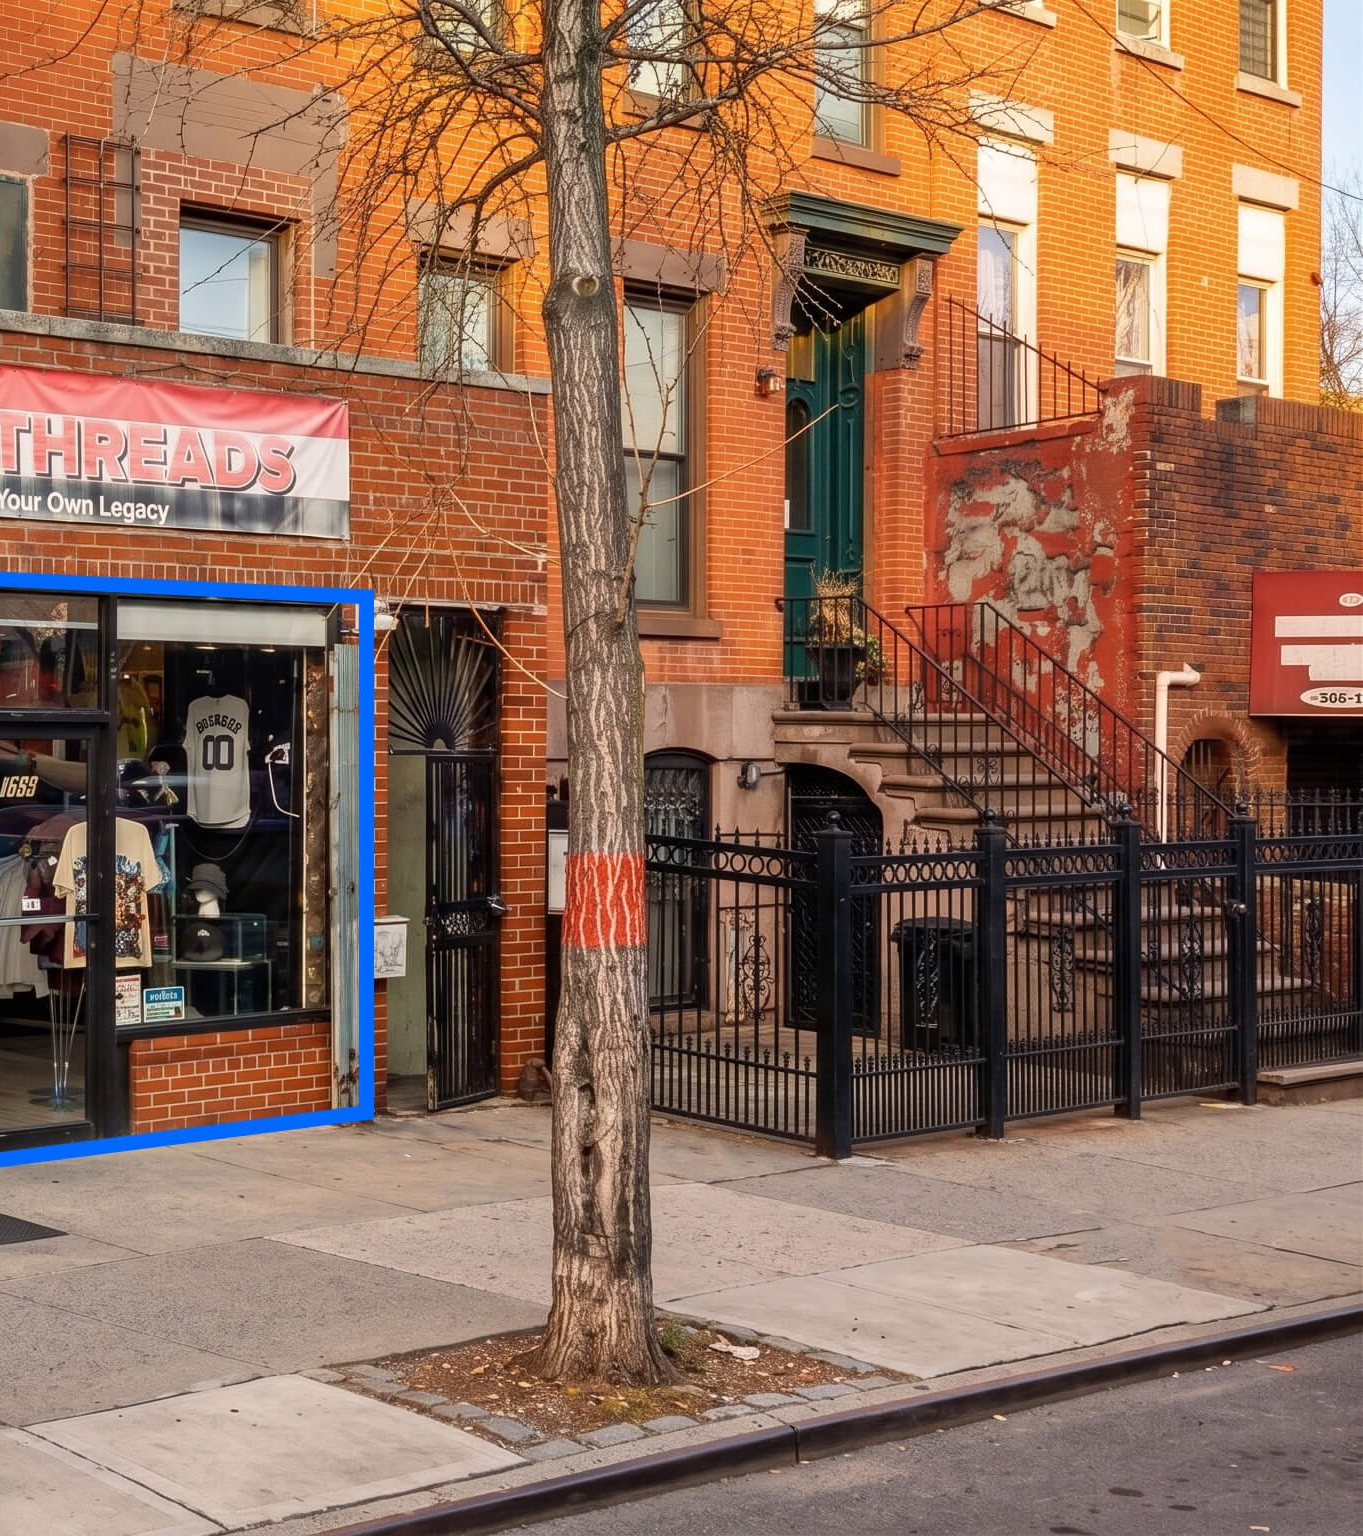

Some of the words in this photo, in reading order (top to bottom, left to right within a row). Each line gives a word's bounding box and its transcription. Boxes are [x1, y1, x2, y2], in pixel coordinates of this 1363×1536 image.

[47, 491, 94, 516] Own
[100, 495, 170, 525] Legacy
[202, 734, 235, 771] 00
